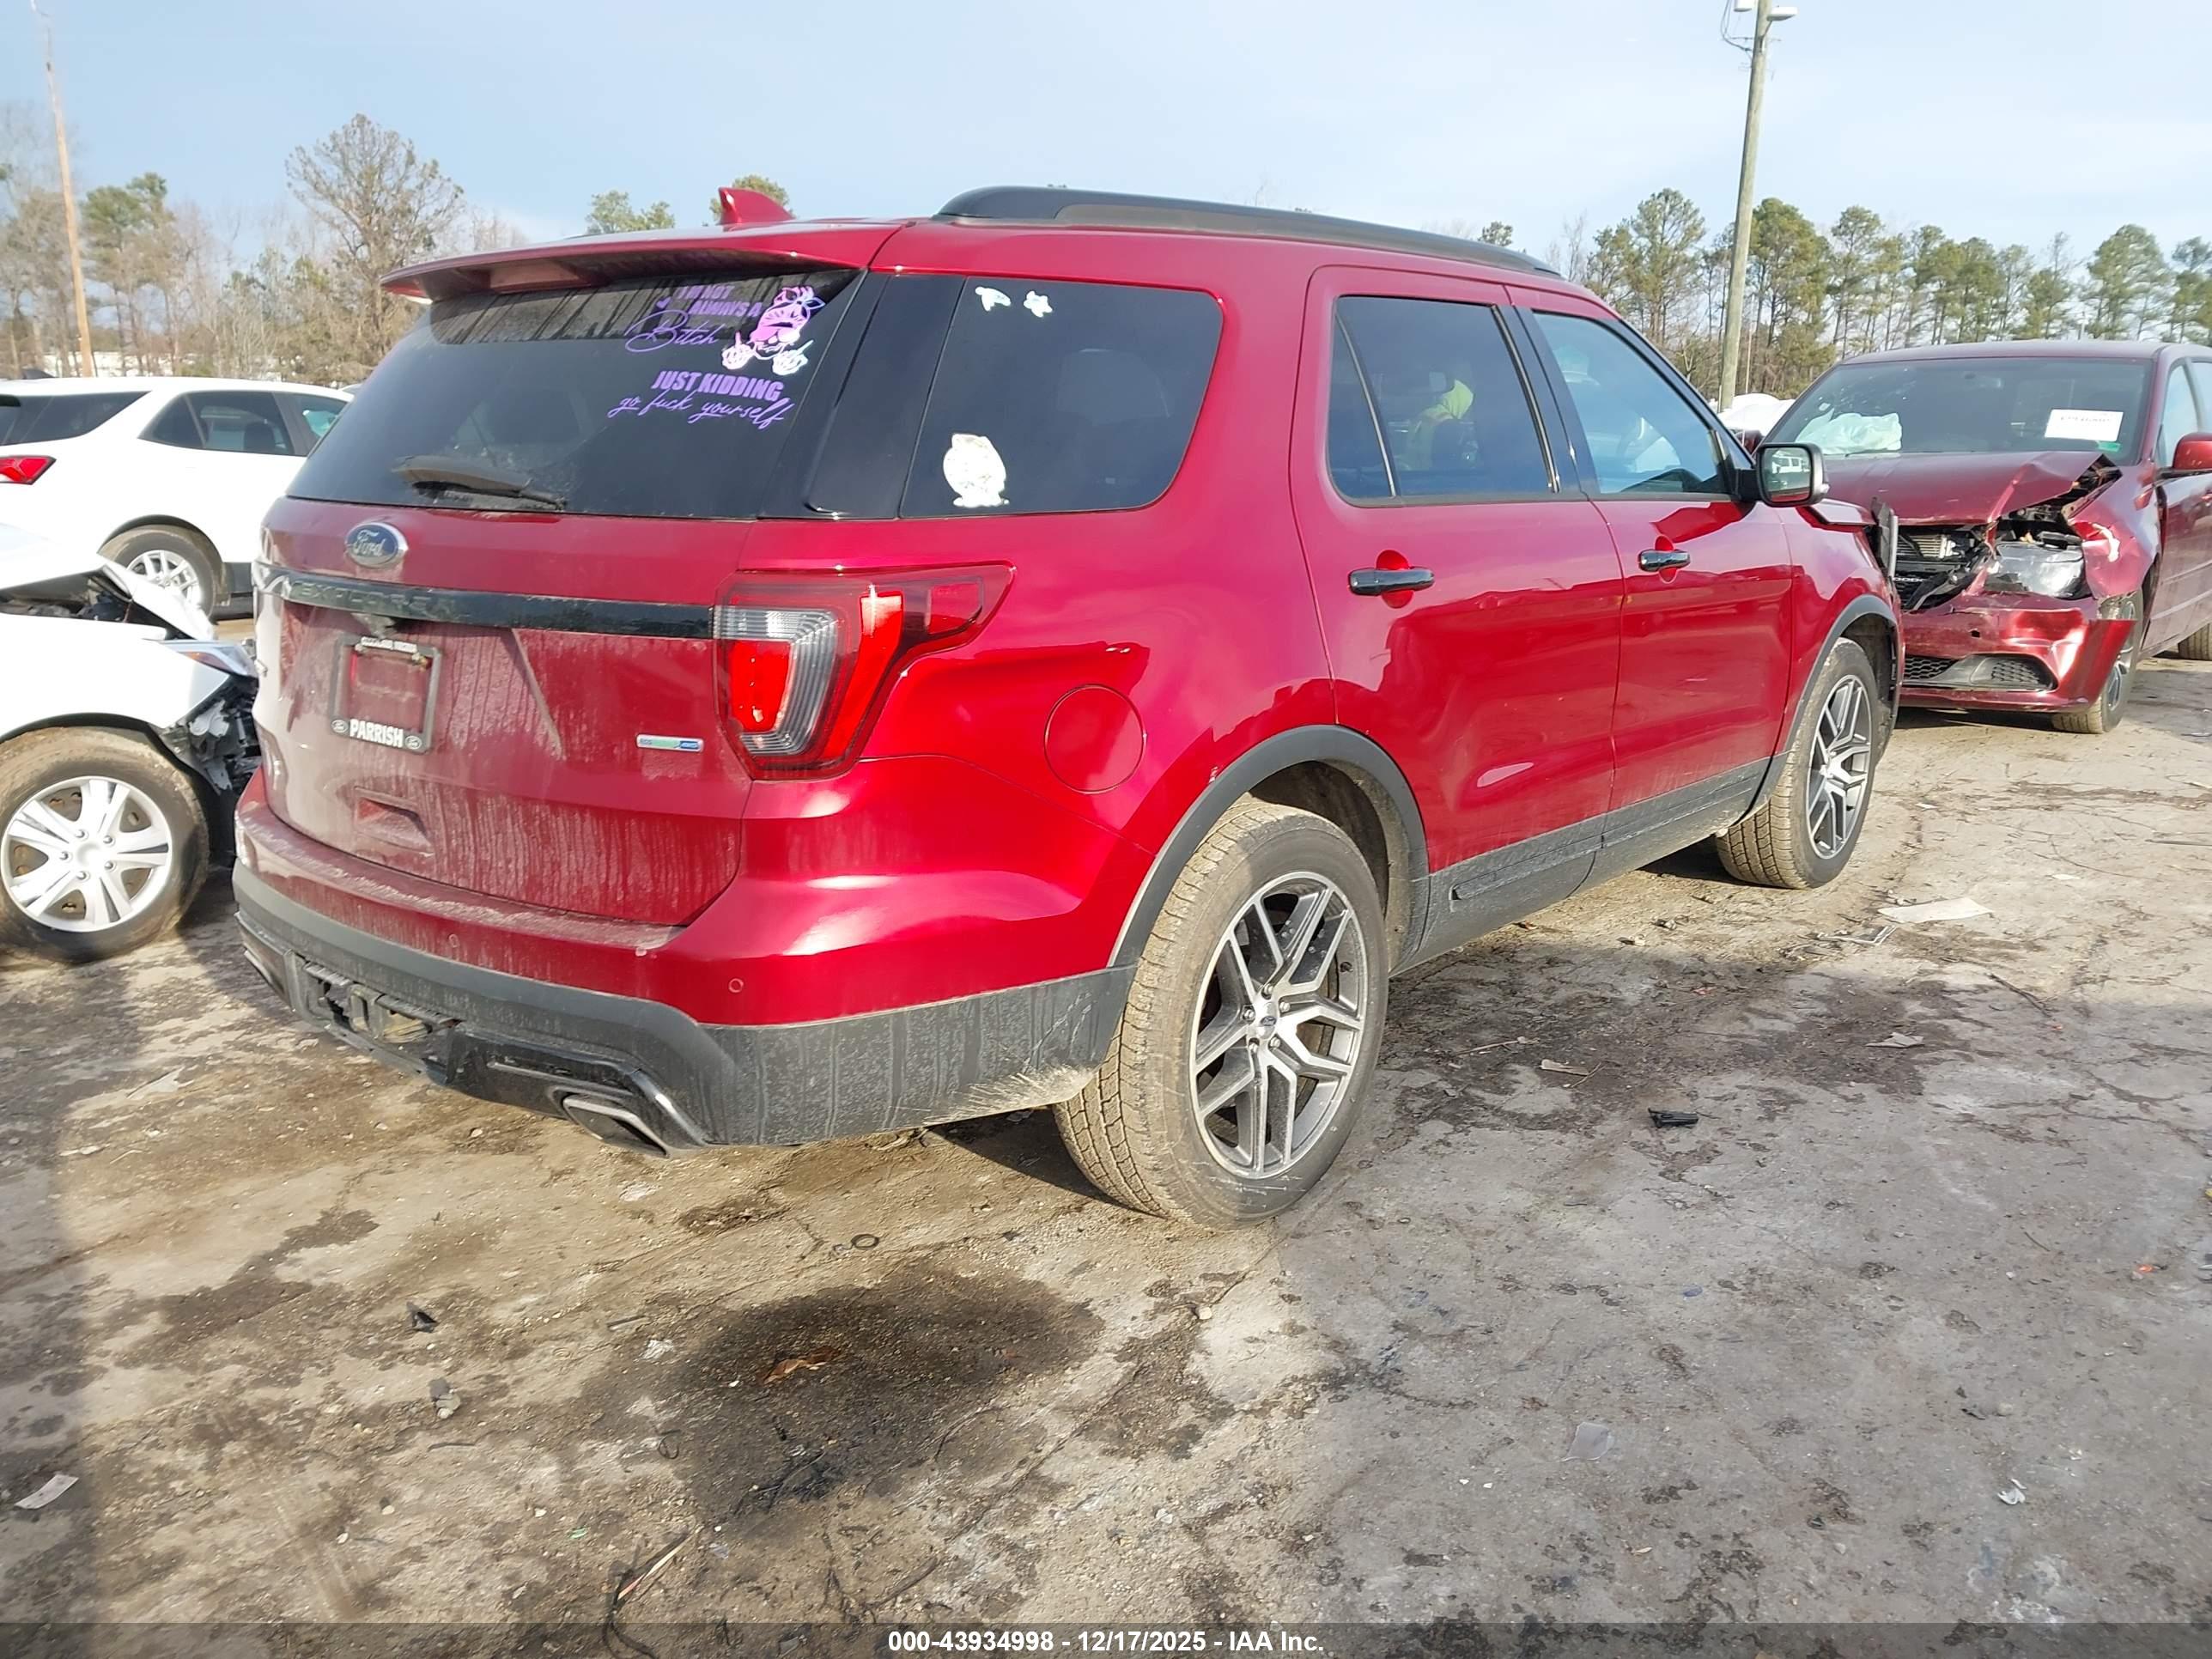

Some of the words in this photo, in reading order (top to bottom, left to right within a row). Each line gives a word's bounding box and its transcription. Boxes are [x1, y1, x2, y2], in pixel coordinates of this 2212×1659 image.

[625, 309, 726, 353] Bitch
[651, 370, 702, 392] JUST
[697, 372, 785, 401] KIDDING
[607, 396, 642, 418] go
[637, 388, 696, 416] fuck
[688, 398, 795, 429] yourself
[353, 528, 387, 557] Ford
[349, 719, 404, 748] PARRISH
